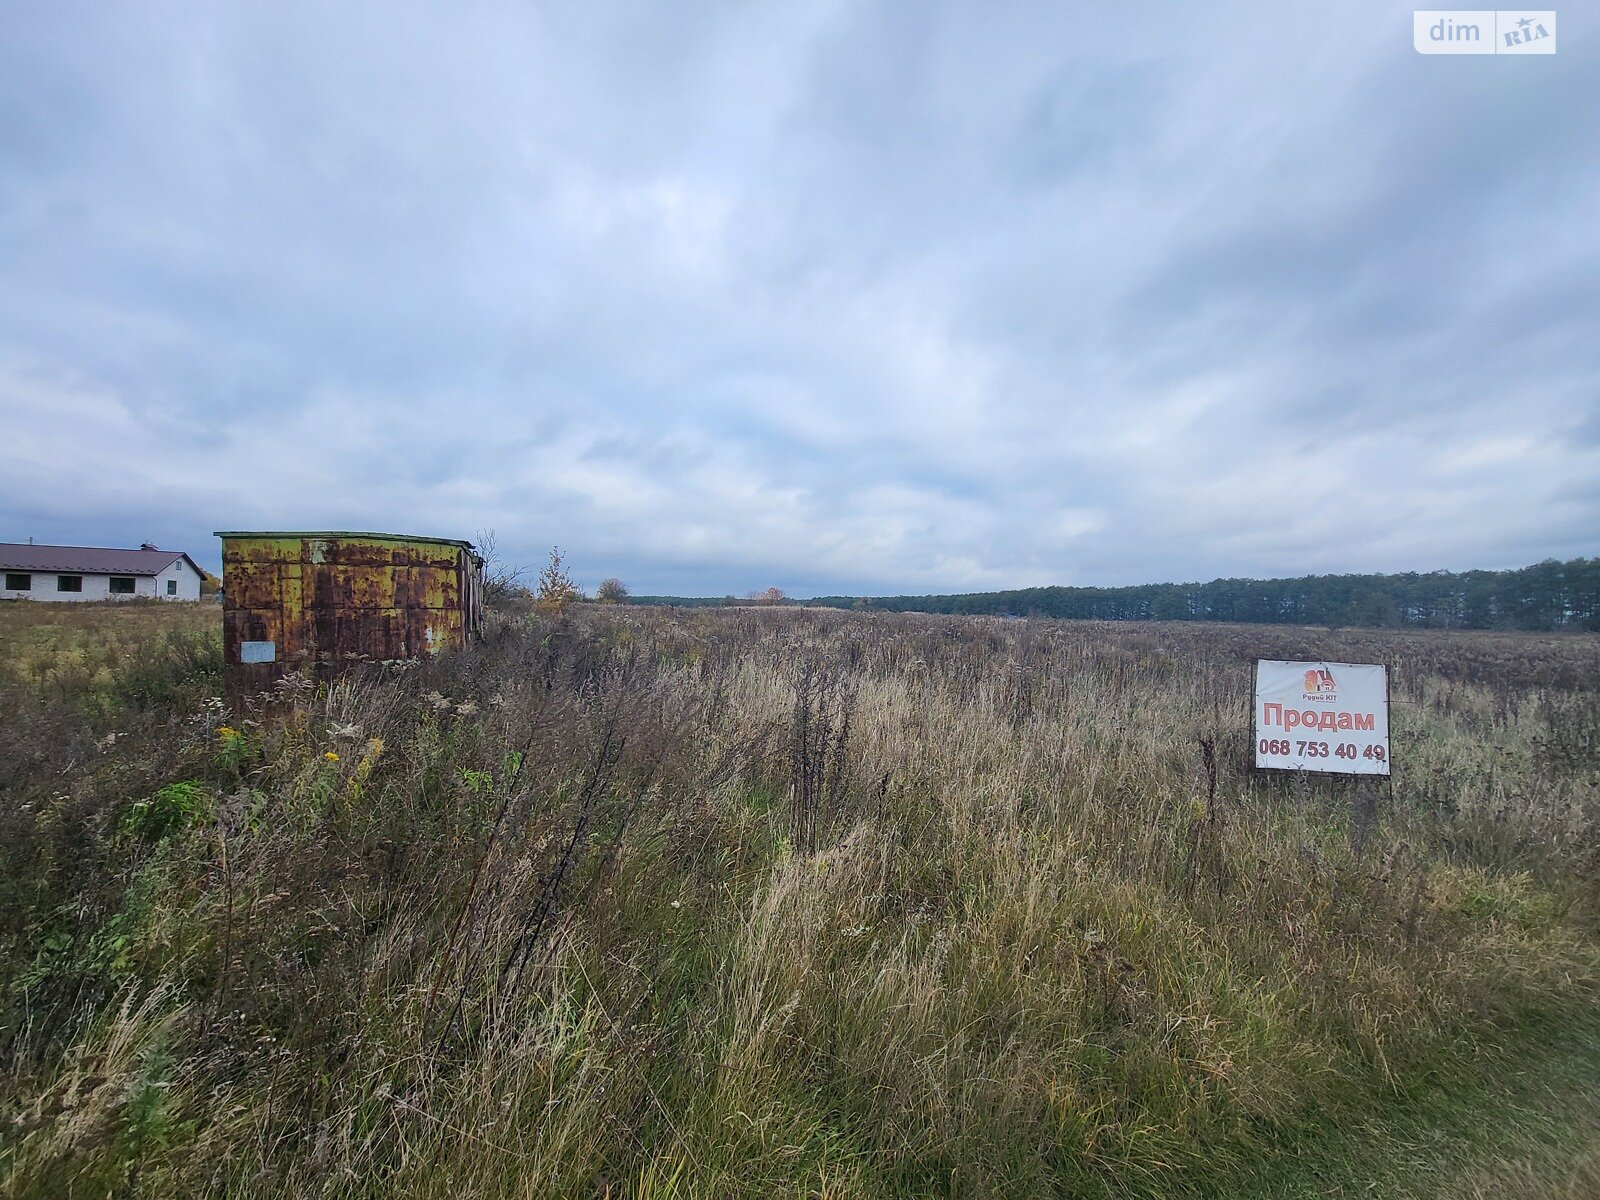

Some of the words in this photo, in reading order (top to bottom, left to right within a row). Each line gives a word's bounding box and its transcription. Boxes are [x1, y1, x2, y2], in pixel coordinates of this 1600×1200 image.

[1263, 702, 1375, 733] Продам
[1259, 738, 1290, 755] 068
[1296, 740, 1329, 758] 753
[1334, 743, 1357, 760] 40
[1362, 744, 1386, 761] 49
